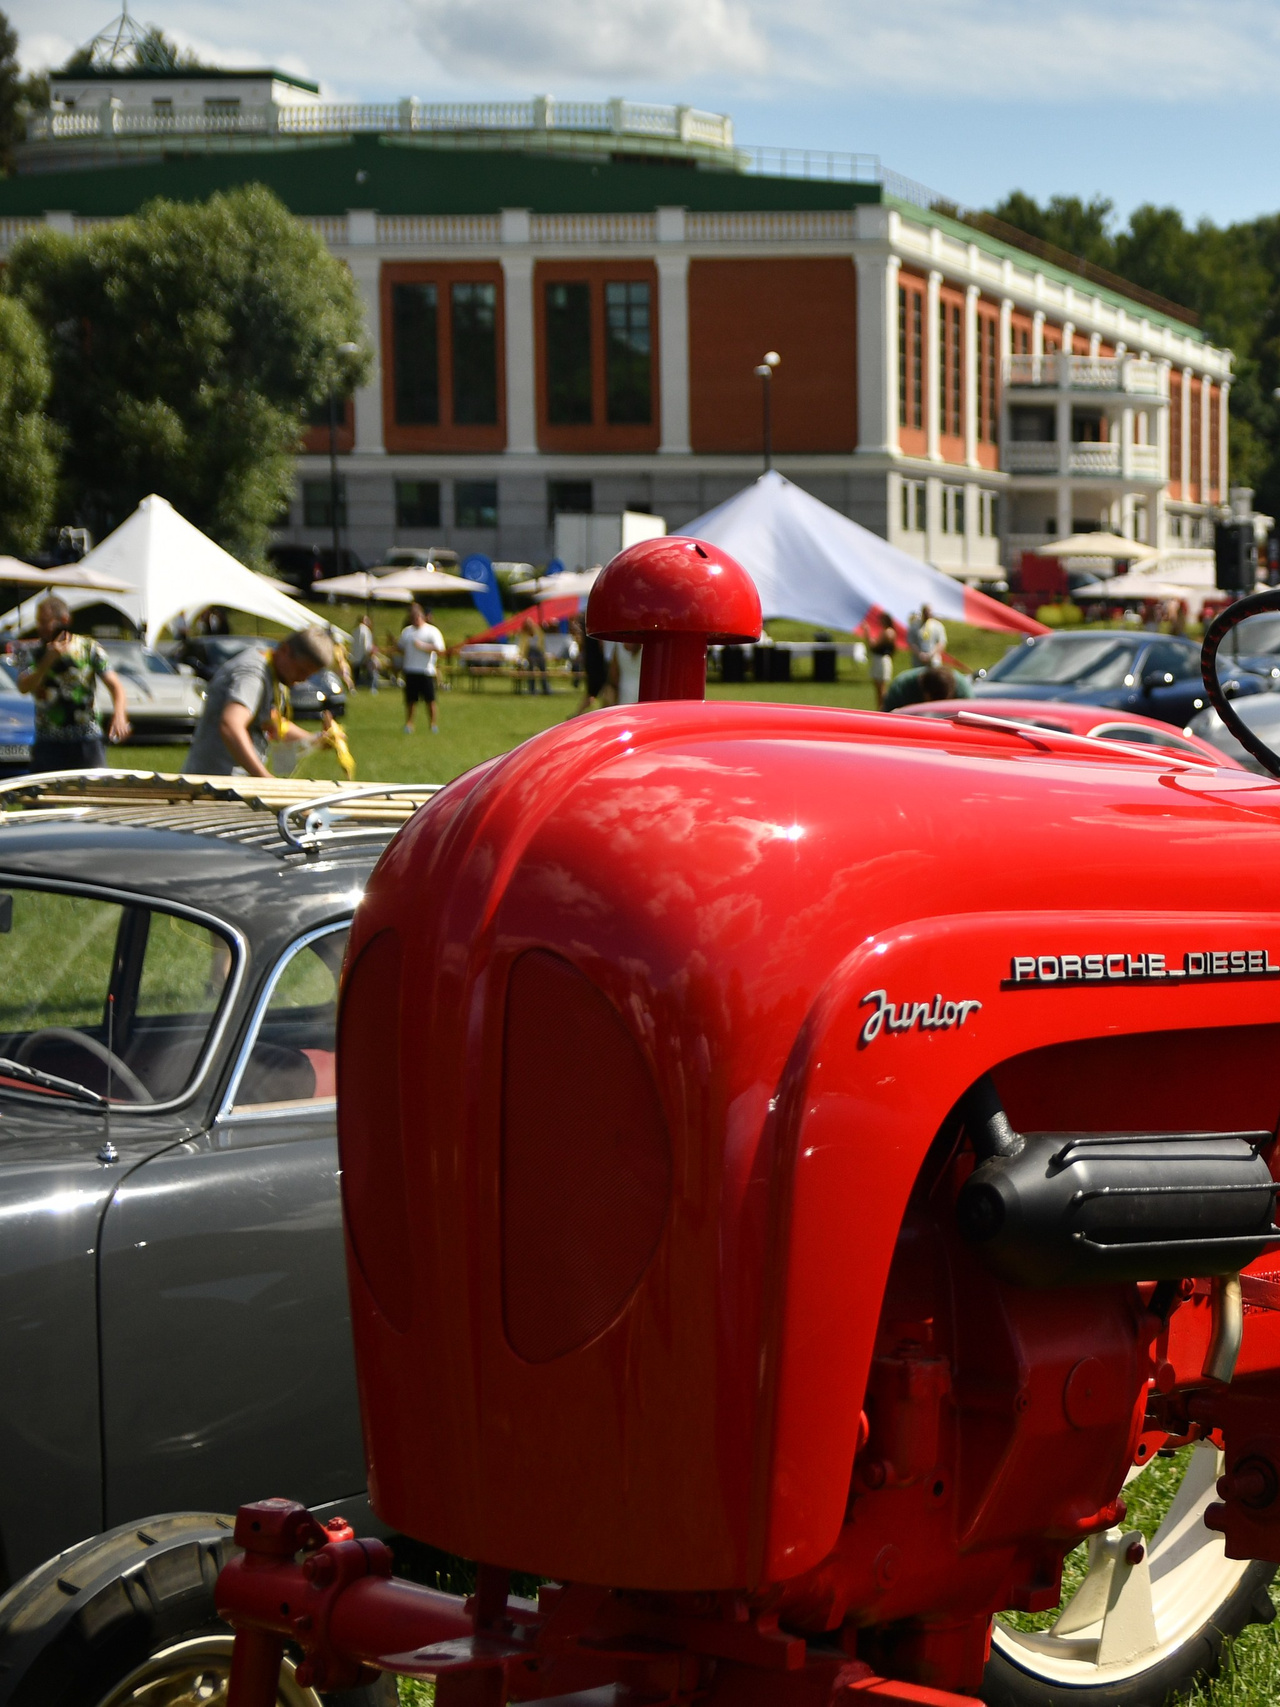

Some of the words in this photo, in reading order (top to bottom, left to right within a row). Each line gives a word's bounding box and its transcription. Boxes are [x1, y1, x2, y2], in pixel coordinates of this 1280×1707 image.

[1011, 953, 1166, 981] PORSCHE
[1184, 949, 1280, 975] DIESEL
[862, 988, 983, 1042] Junior
